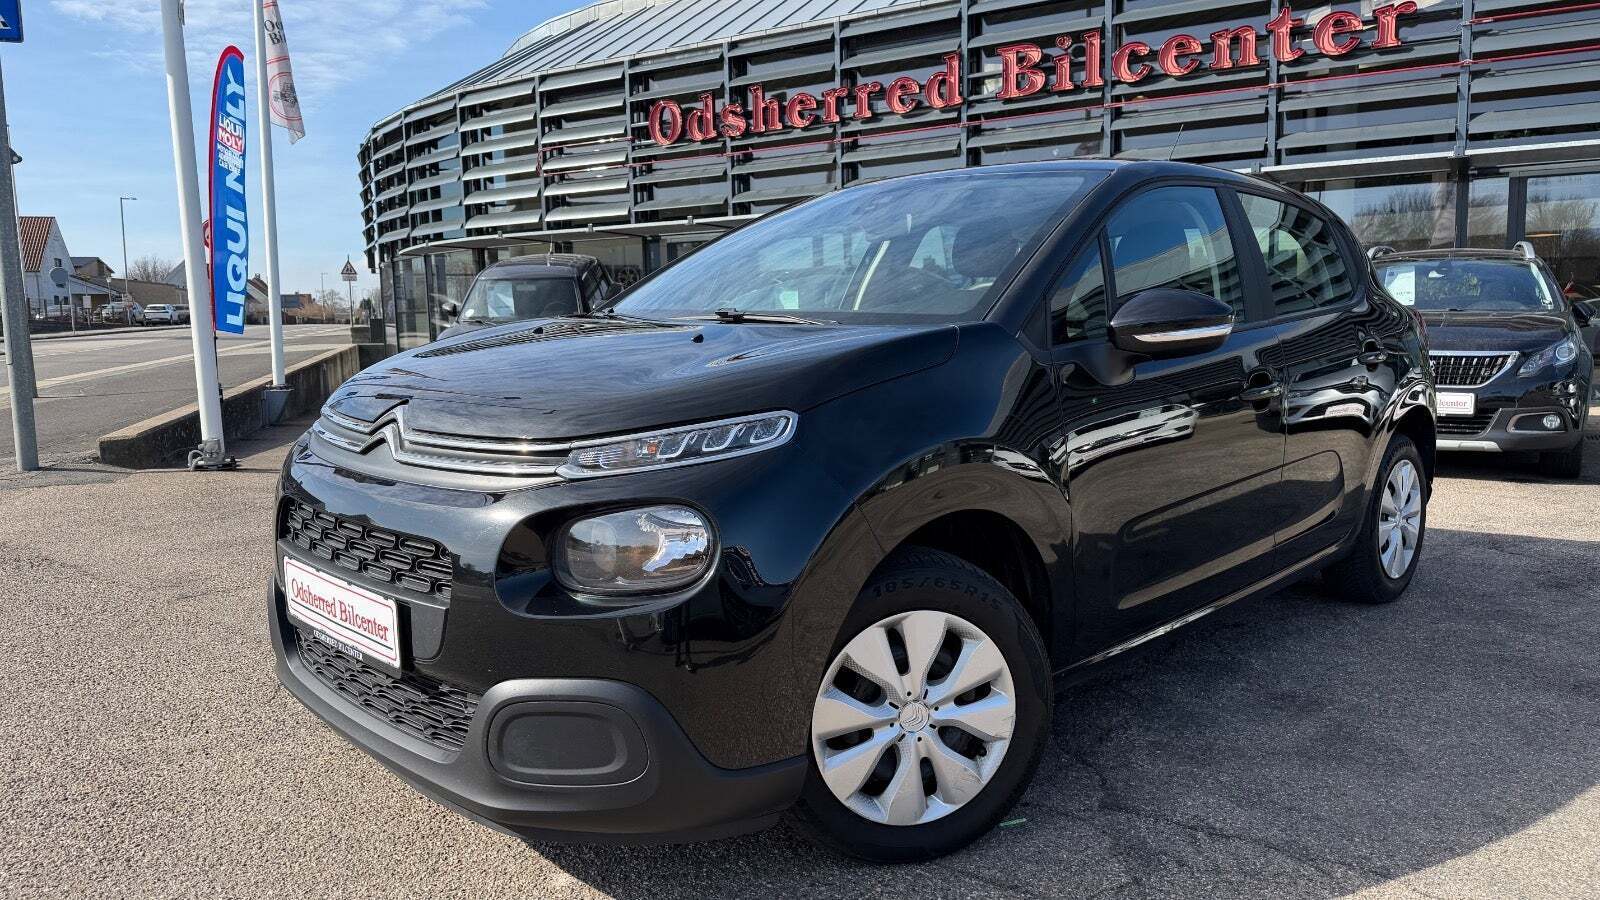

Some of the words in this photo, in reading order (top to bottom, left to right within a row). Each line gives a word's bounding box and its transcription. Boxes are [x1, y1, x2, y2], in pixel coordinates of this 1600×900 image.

[648, 51, 964, 146] Odsherred
[996, 1, 1418, 99] Bilcenter
[218, 113, 244, 139] LIQUI
[218, 127, 243, 153] MOLY
[225, 205, 247, 327] LIQUI
[291, 578, 338, 619] Odsherred
[338, 600, 389, 642] Bilcenter
